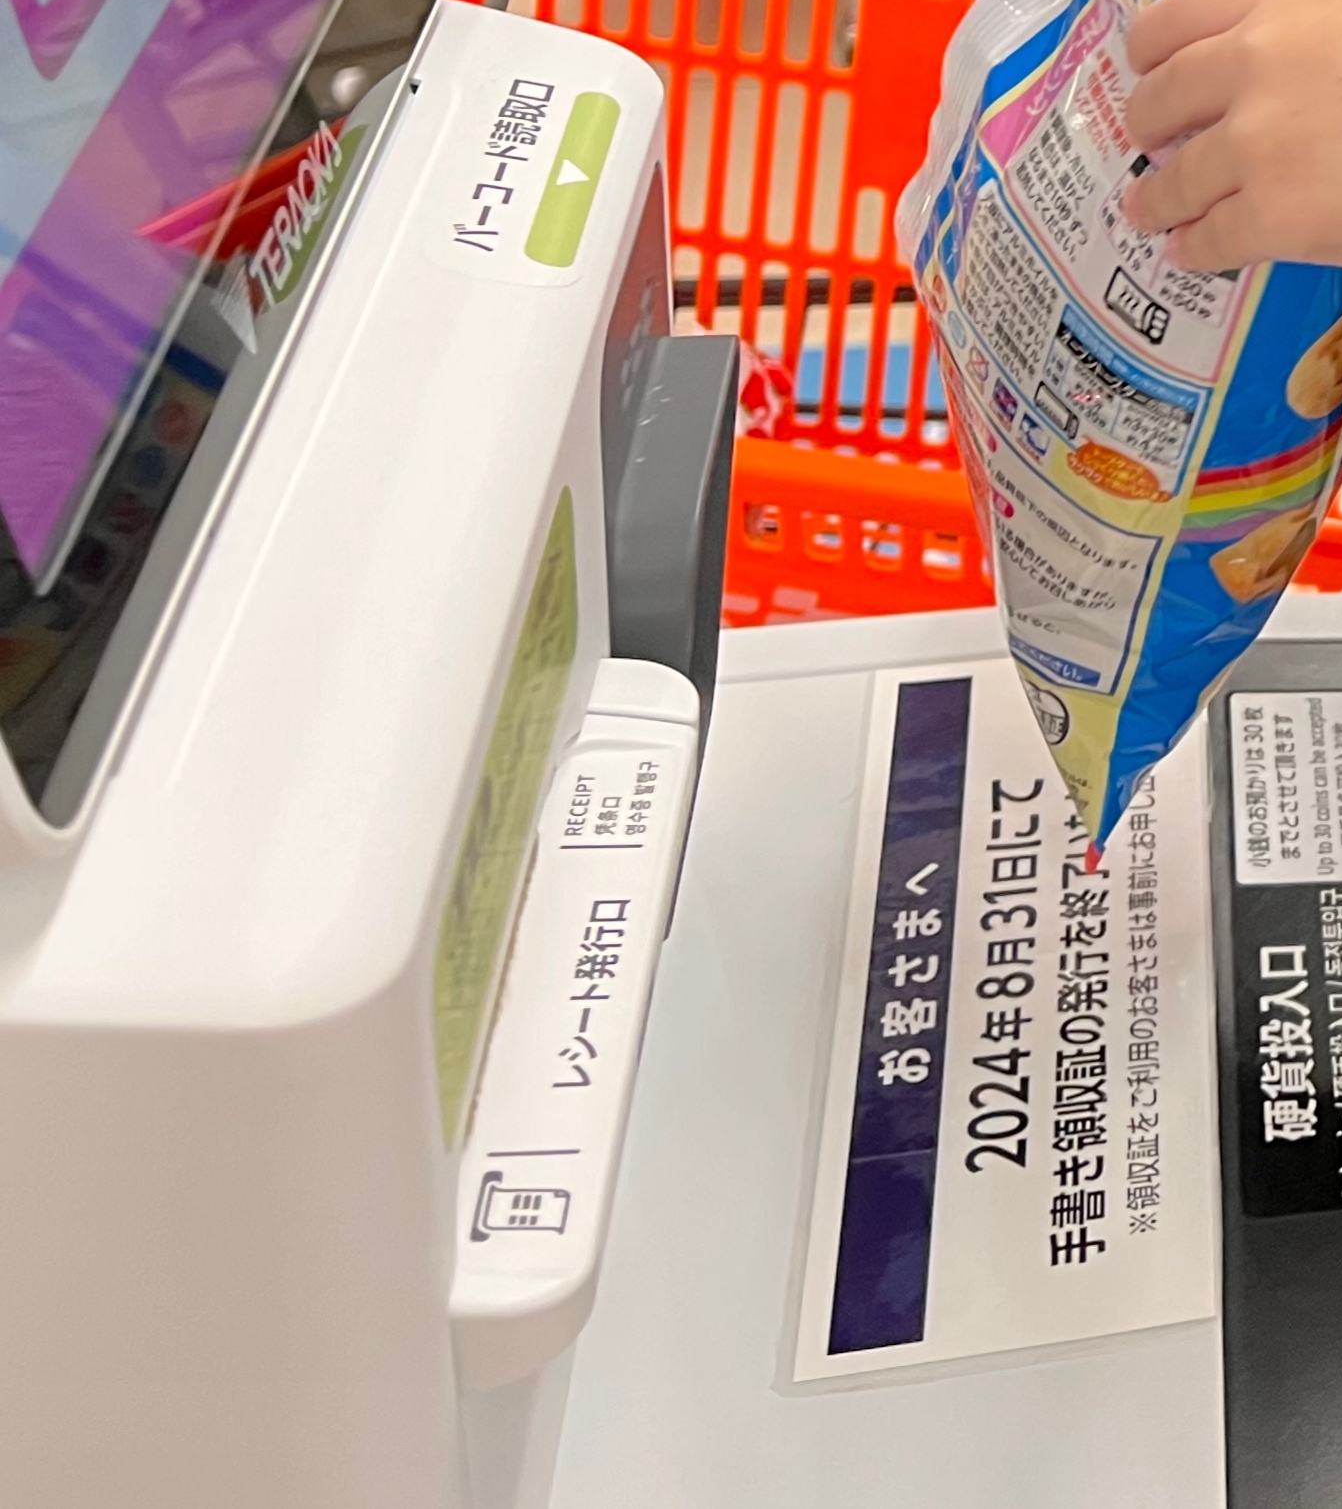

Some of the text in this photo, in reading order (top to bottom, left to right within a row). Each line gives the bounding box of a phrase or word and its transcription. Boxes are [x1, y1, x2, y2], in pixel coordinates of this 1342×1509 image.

[452, 79, 555, 252] バーコード読取口
[1243, 706, 1263, 721] 枚
[1244, 724, 1263, 743] 30
[1306, 697, 1338, 875] Up to 30 coins can be accepted
[564, 774, 596, 836] RECEIPT
[551, 899, 632, 1088] レシート発行口
[876, 861, 943, 1086] お客さまへ
[964, 777, 1044, 1175] 2024年8月31日にて
[1259, 944, 1318, 1143] 硬貨投入口
